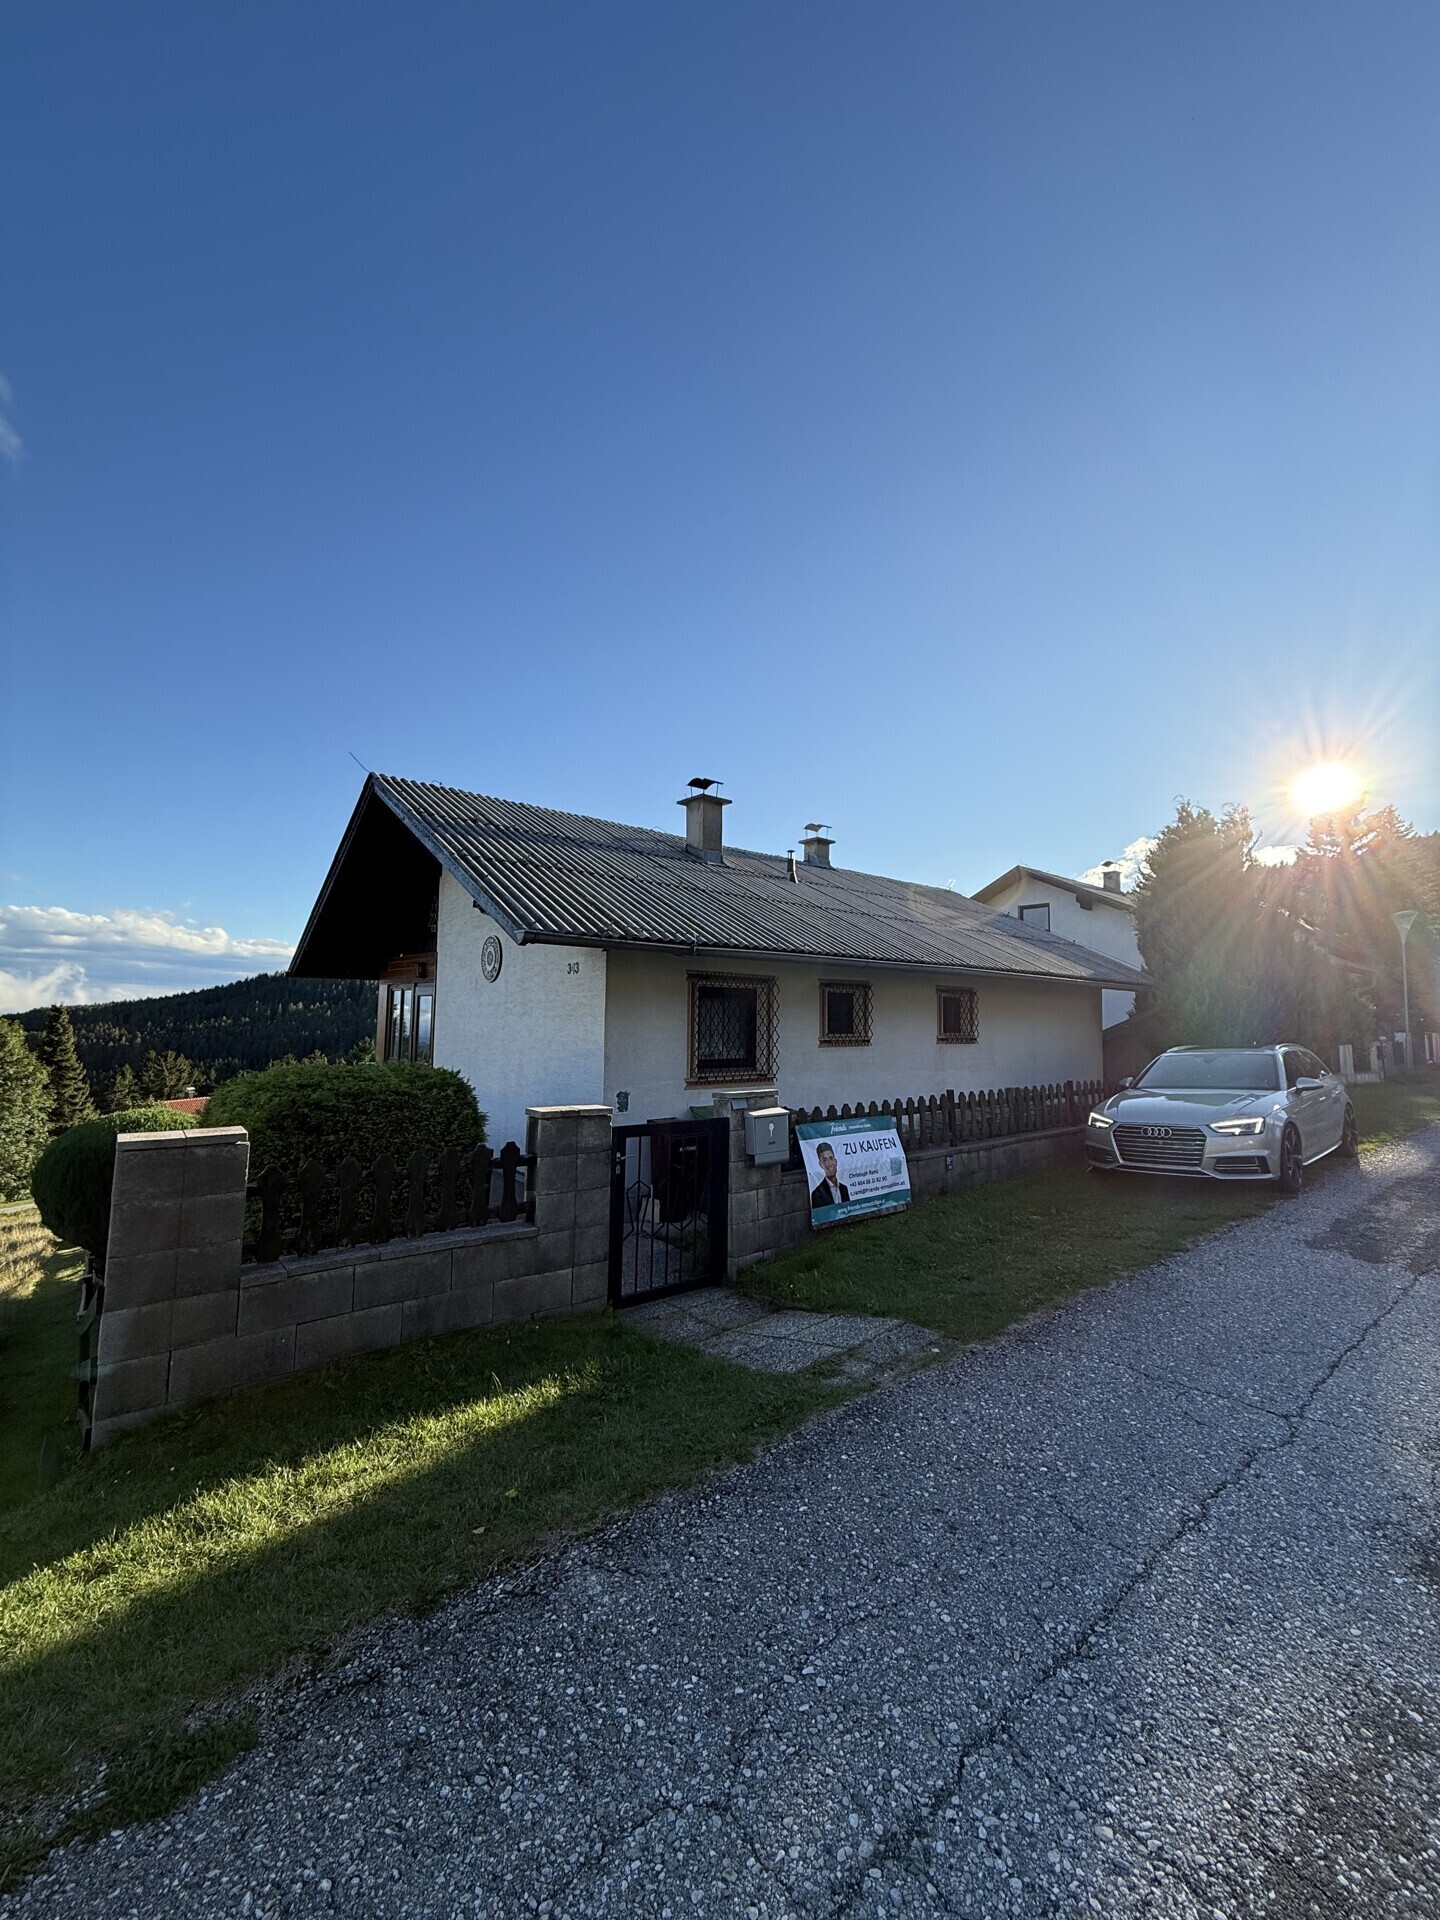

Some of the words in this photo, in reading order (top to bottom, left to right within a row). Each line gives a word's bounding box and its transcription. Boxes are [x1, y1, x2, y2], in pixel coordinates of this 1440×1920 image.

[843, 1143, 857, 1155] ZU
[858, 1137, 897, 1153] KAUFEN
[849, 1170, 868, 1178] Christoph
